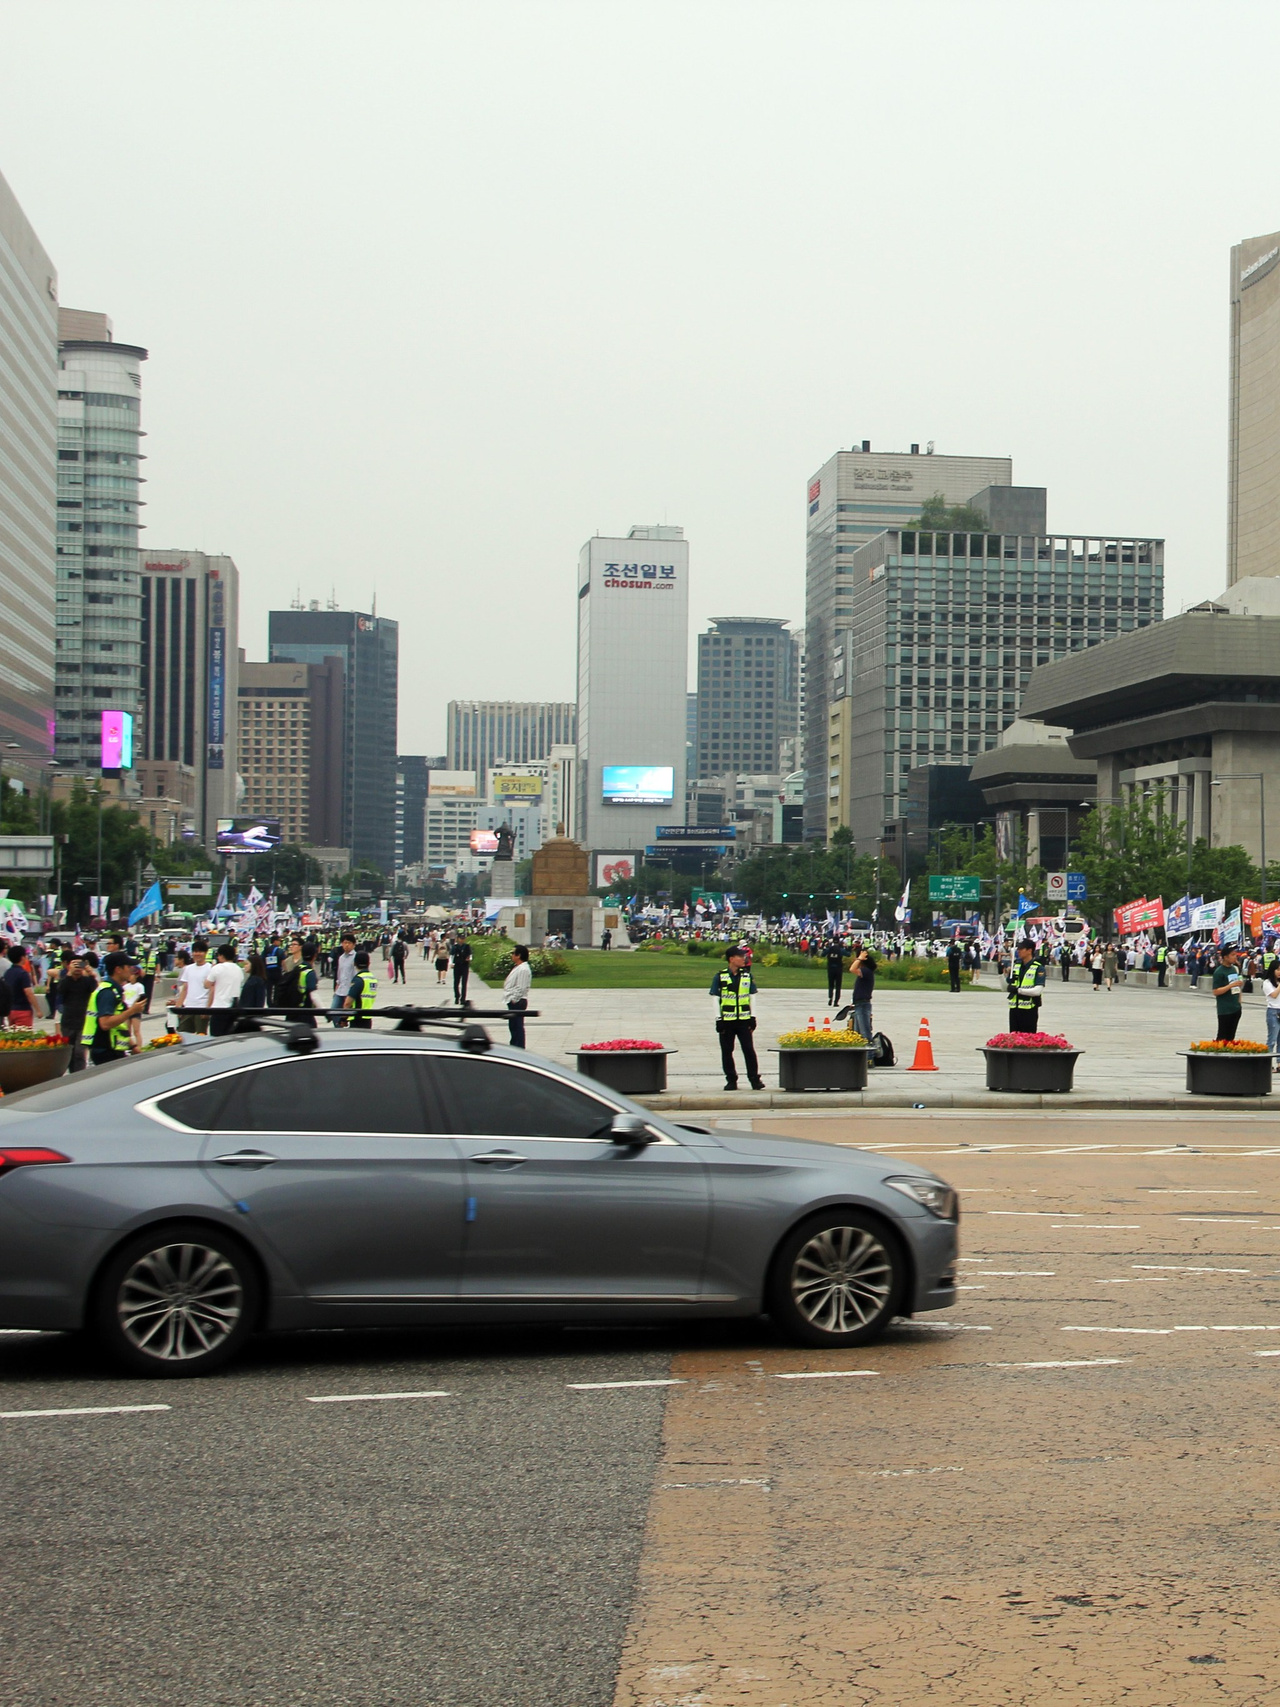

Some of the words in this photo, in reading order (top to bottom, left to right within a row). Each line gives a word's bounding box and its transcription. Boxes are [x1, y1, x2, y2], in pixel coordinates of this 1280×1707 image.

[145, 561, 183, 571] kobaco
[602, 563, 677, 578] 조선일보
[604, 578, 674, 590] chosun.com
